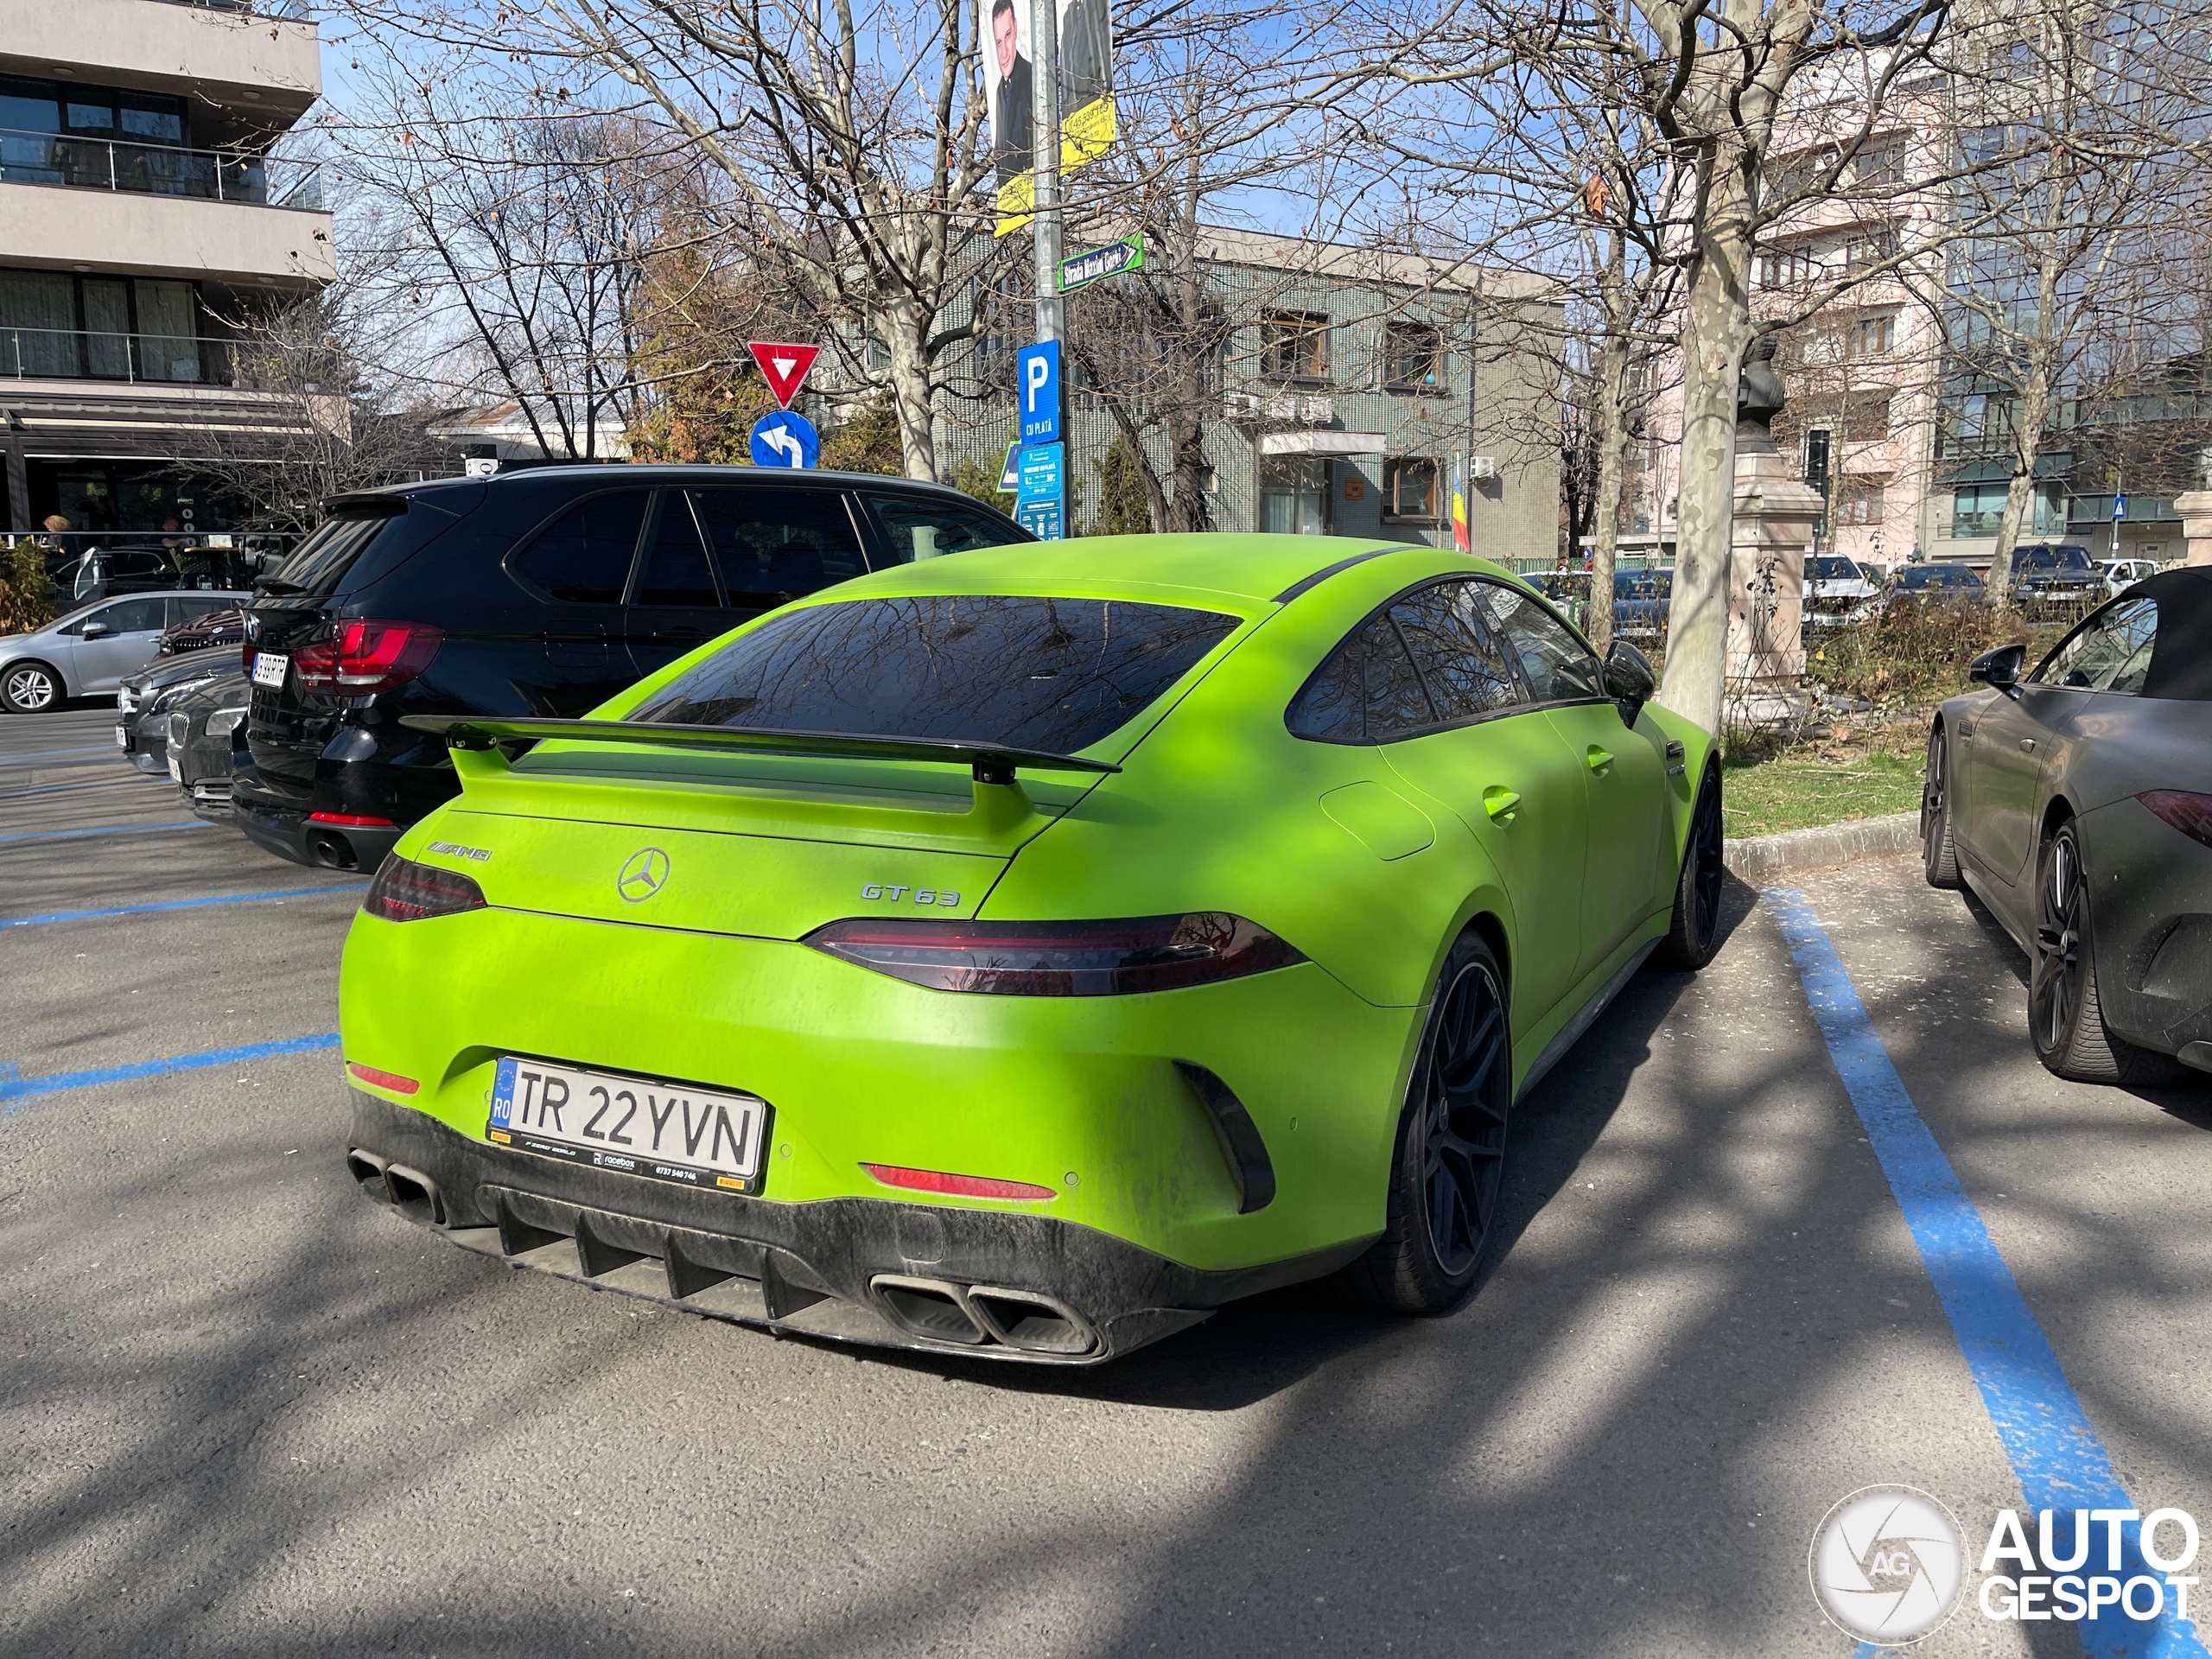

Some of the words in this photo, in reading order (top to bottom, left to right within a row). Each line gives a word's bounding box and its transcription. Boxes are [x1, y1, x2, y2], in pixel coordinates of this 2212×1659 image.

[1064, 262, 1084, 285] Strada
[1084, 255, 1104, 278] Maxim
[1027, 356, 1048, 413] P
[1026, 423, 1034, 436] CU
[1034, 418, 1052, 435] PLATĂ
[861, 884, 910, 901] GT
[914, 888, 961, 906] 63
[493, 1096, 511, 1120] RO
[520, 1071, 570, 1133] TR
[582, 1085, 638, 1146] 22
[647, 1094, 752, 1166] YVN
[531, 1142, 551, 1151] ZERO
[551, 1147, 576, 1156] WORLD
[605, 1155, 635, 1168] racebox
[656, 1166, 671, 1176] 0737
[671, 1169, 683, 1179] 540
[683, 1171, 696, 1180] 746
